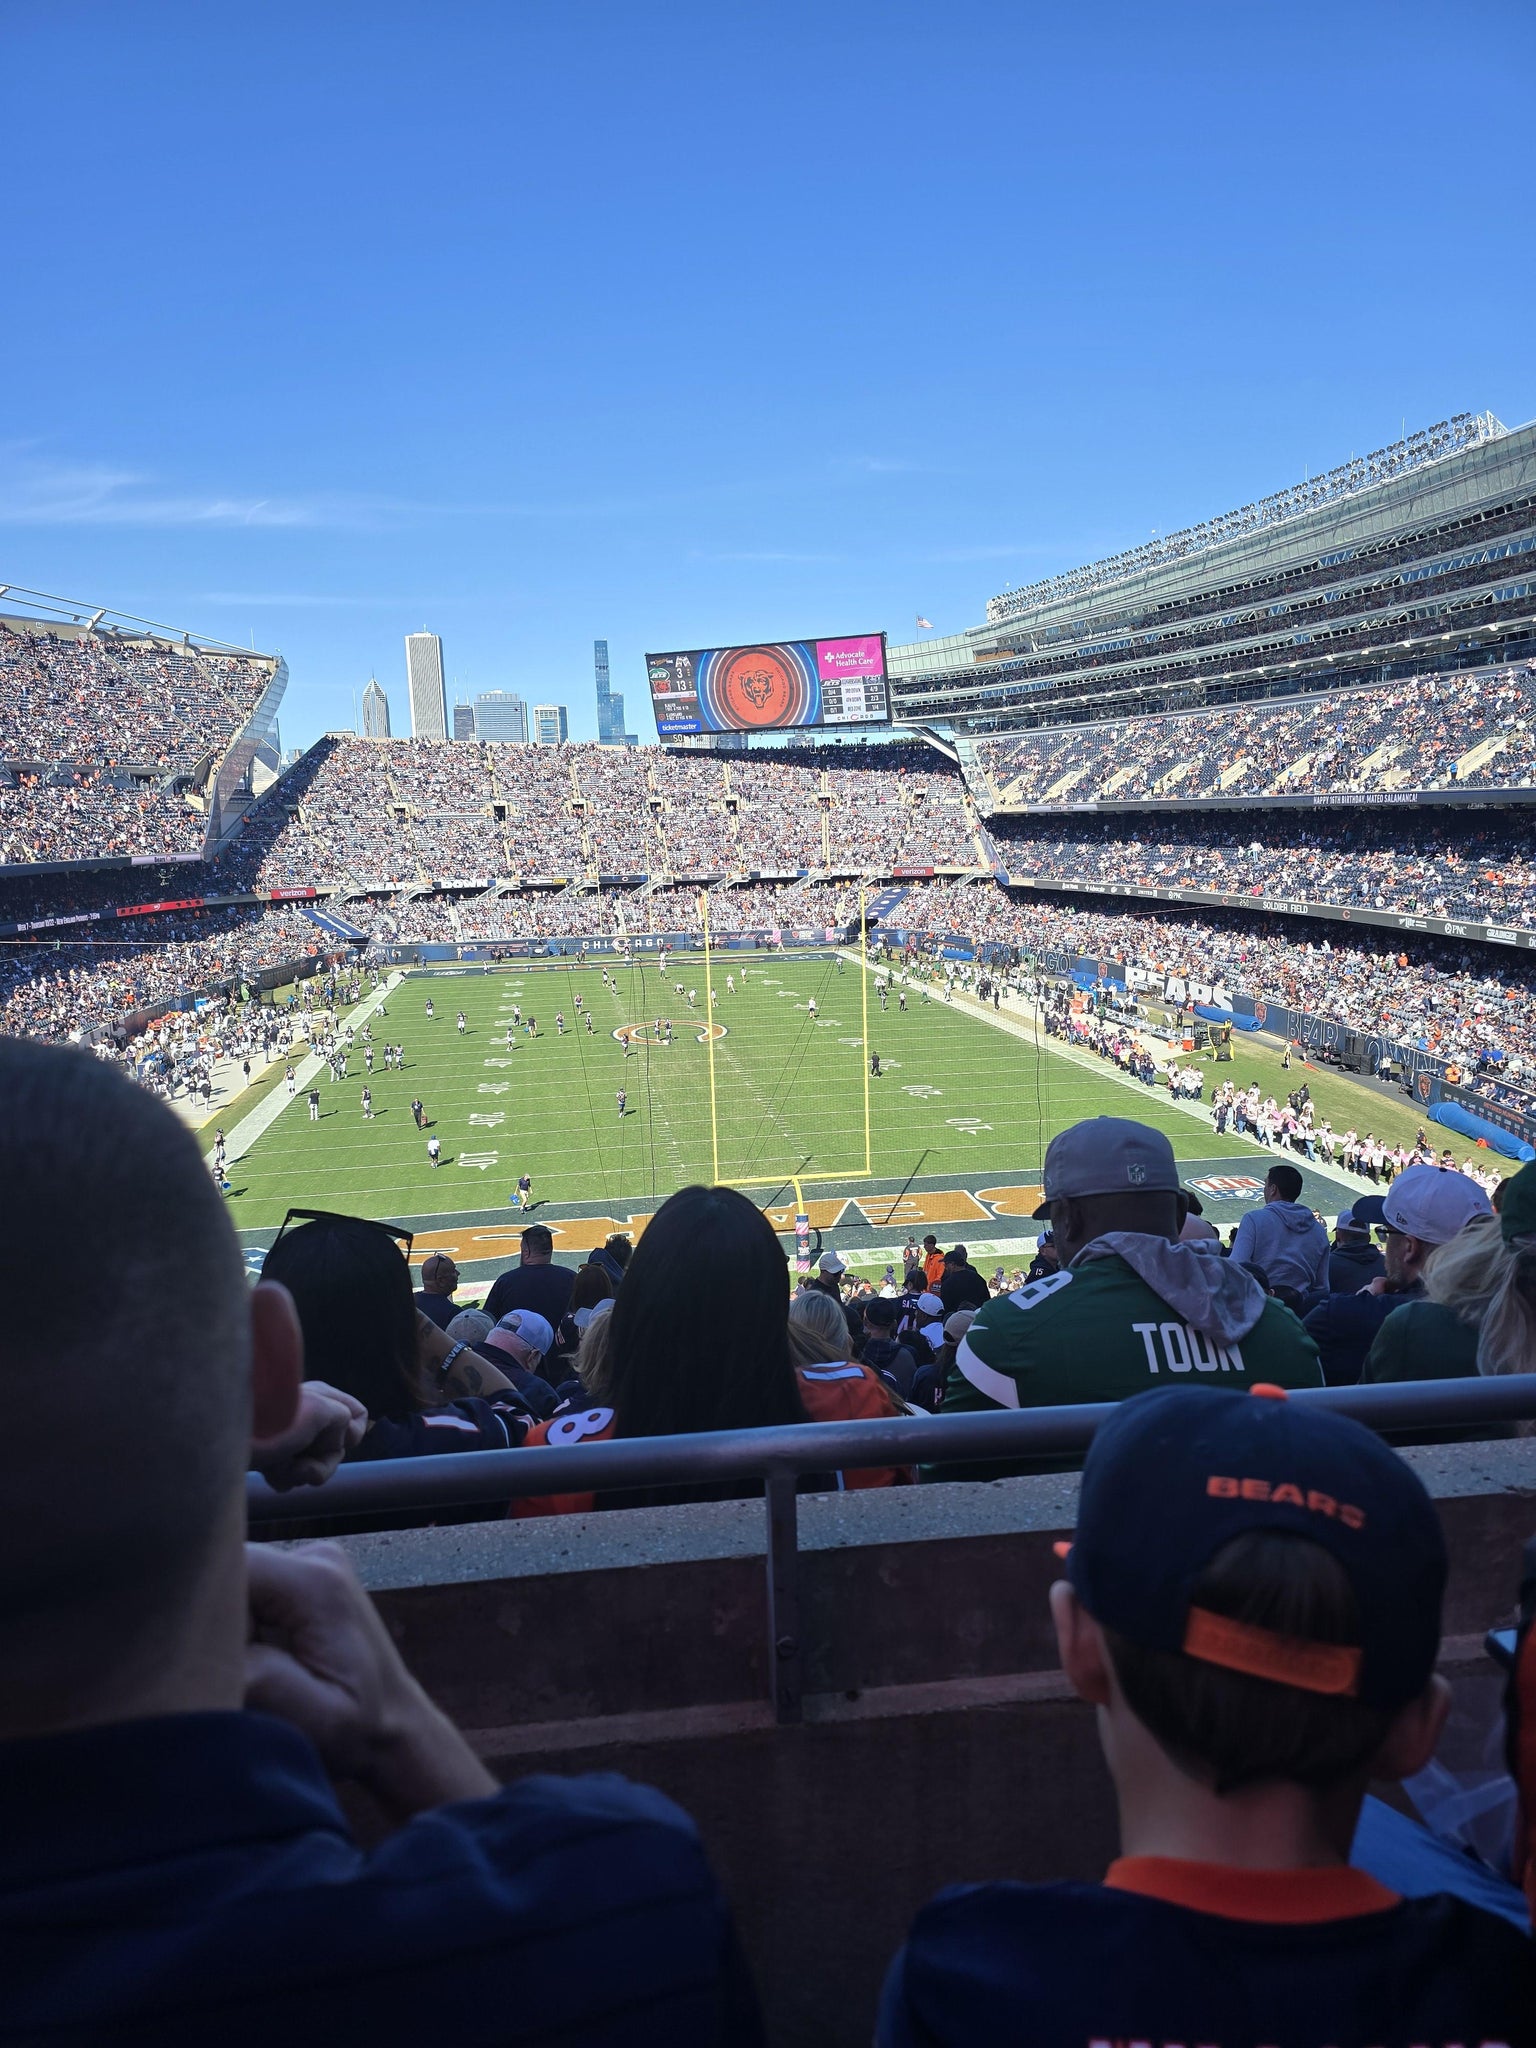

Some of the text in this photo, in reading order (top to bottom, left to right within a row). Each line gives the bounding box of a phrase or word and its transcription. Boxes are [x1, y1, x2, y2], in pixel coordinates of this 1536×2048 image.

[836, 651, 865, 659] Advocate
[836, 659, 857, 667] Health
[676, 668, 683, 678] 3
[676, 680, 687, 691] 13
[1313, 795, 1329, 805] HAPPY
[1342, 794, 1366, 805] BIRTHDAY,
[1367, 794, 1384, 803] MATEO
[1384, 793, 1418, 803] SALAMANCA!
[901, 867, 926, 875] verizon
[442, 879, 488, 889] DOWN
[279, 889, 307, 897] verizon
[1262, 901, 1309, 914] SOLDIER FIELD
[1452, 924, 1467, 936] PNC
[1486, 928, 1518, 941] GRAINGER
[582, 936, 664, 953] CHICAGO
[945, 1117, 993, 1132] 10
[458, 1150, 499, 1167] 10
[1194, 1177, 1260, 1190] NFL
[1035, 1267, 1044, 1276] 15
[1008, 1270, 1073, 1310] 8
[1132, 1322, 1245, 1373] TOON
[1206, 1475, 1366, 1530] BEARS
